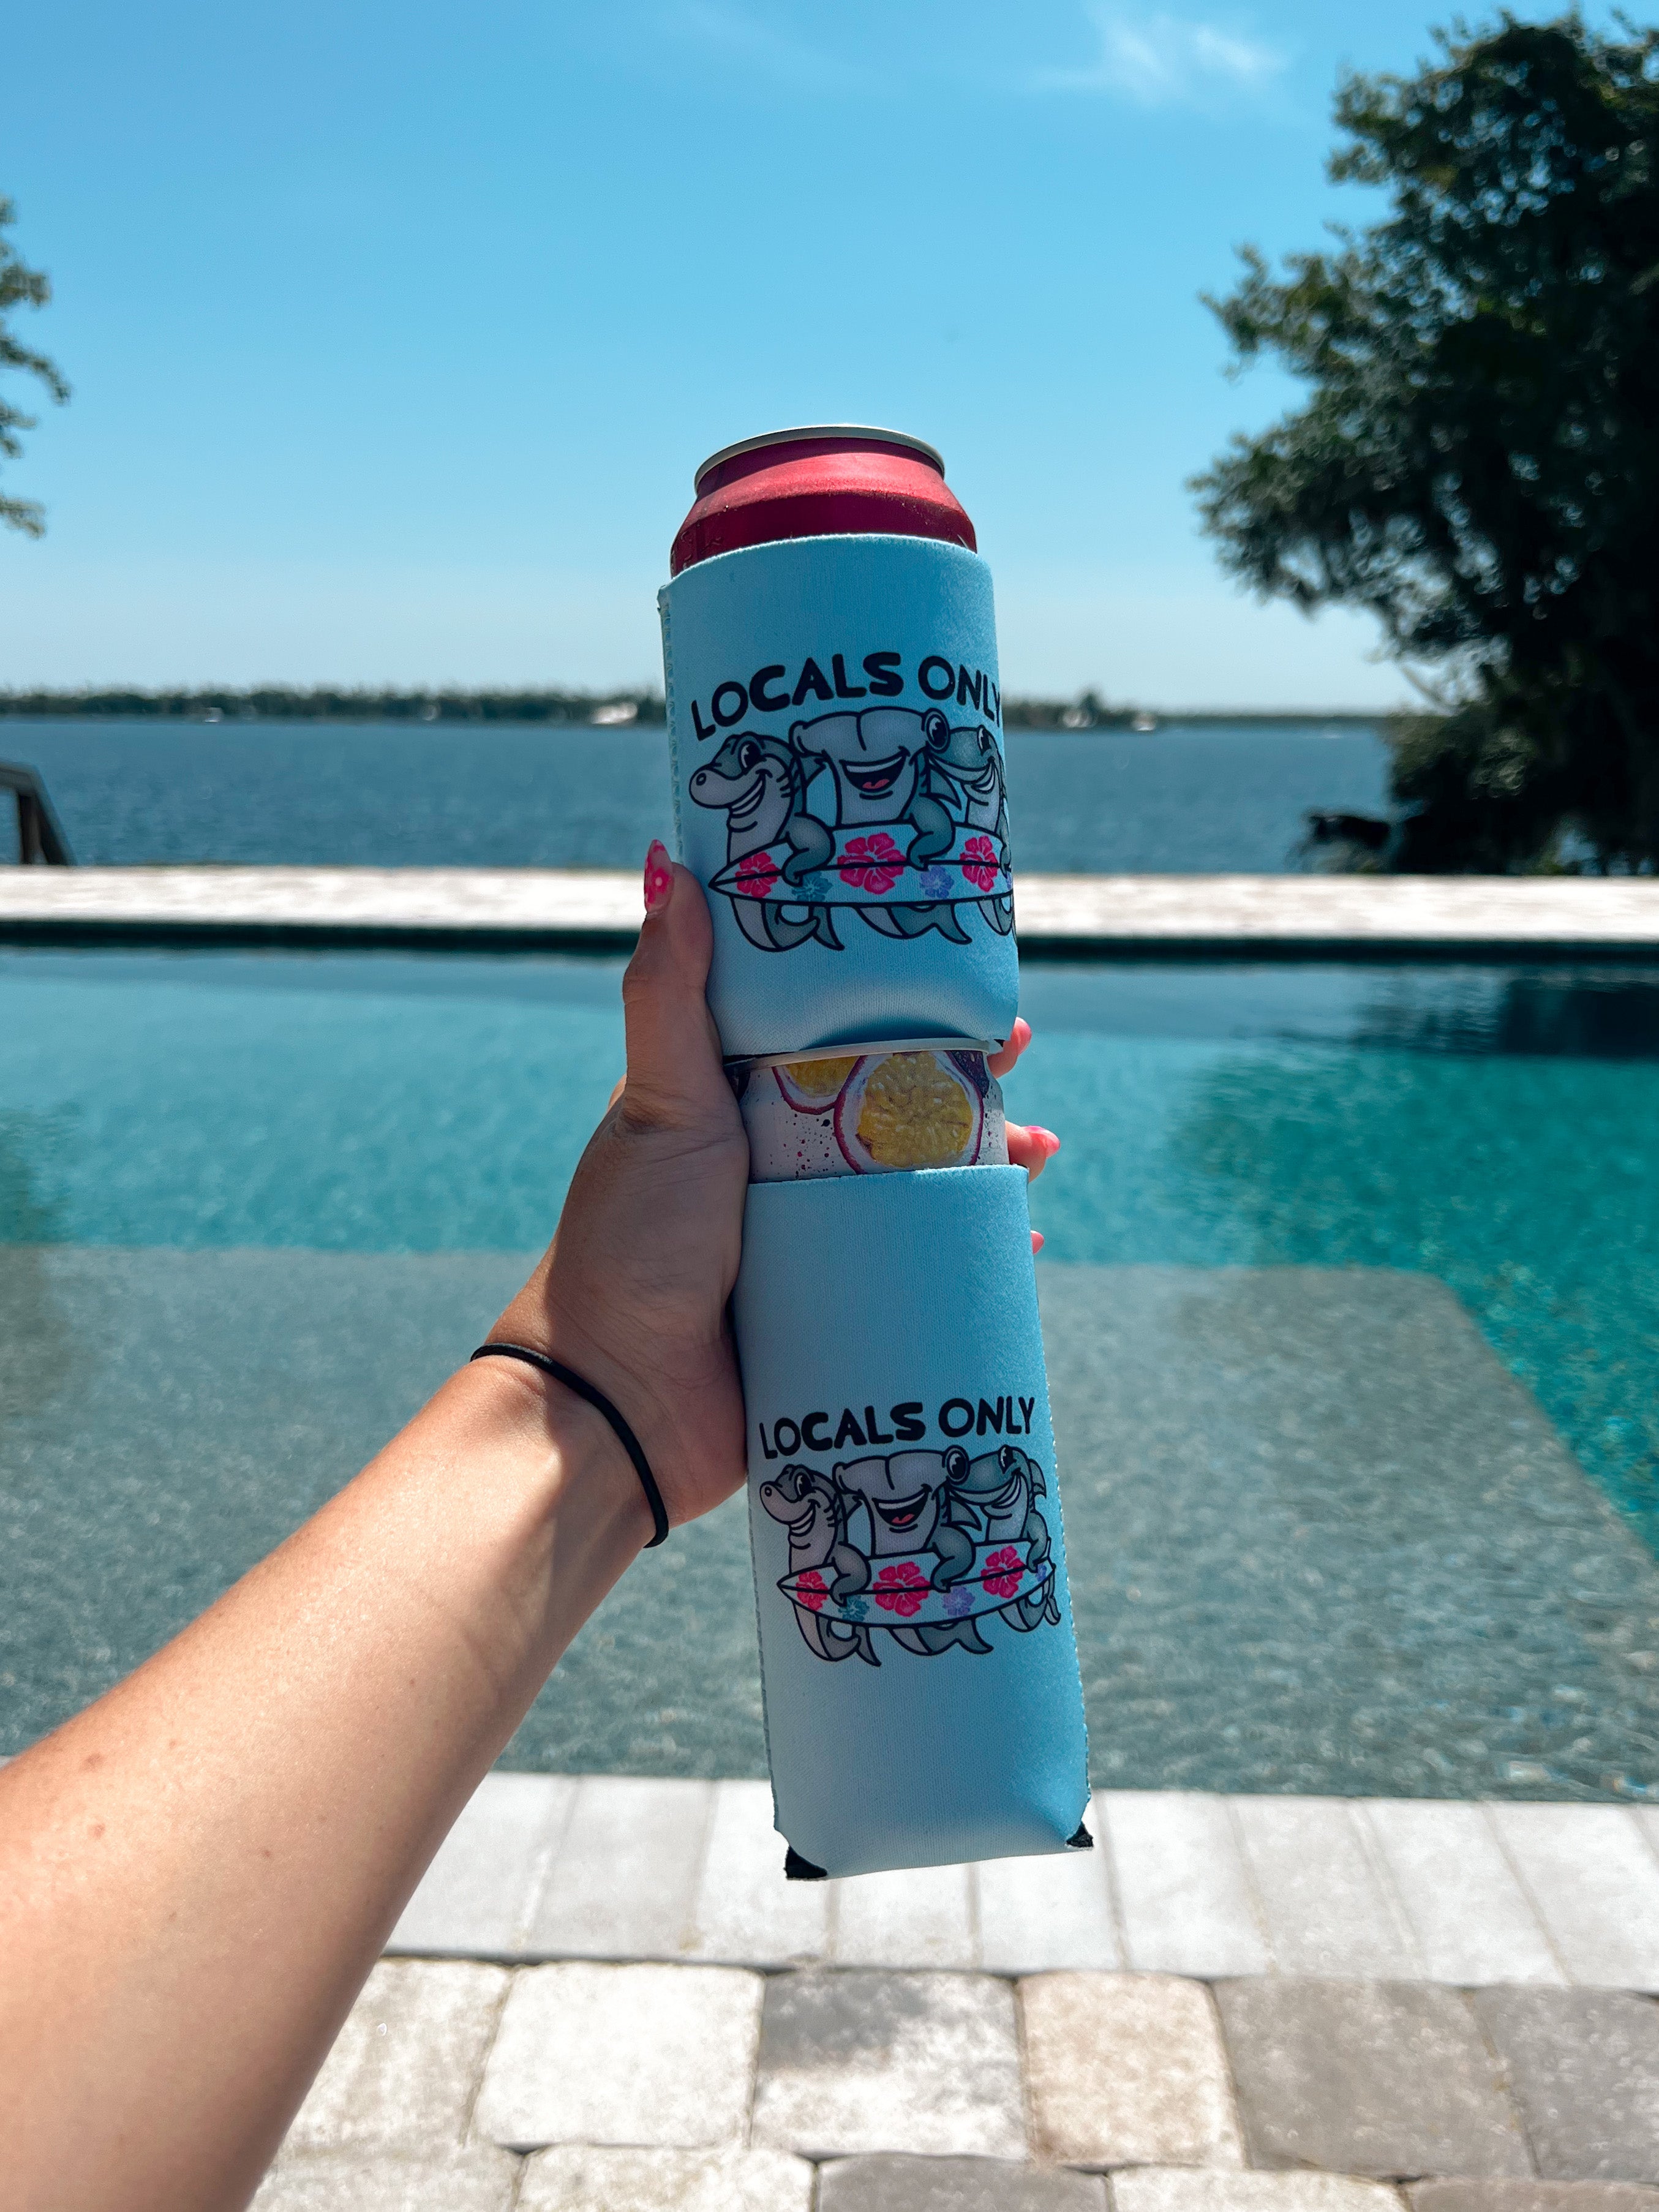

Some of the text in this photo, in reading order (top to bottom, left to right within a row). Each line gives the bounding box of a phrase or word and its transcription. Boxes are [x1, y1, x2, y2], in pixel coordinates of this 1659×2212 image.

[691, 652, 1000, 741] LOCALS ONLY
[759, 1396, 1035, 1459] LOCALS ONLY
